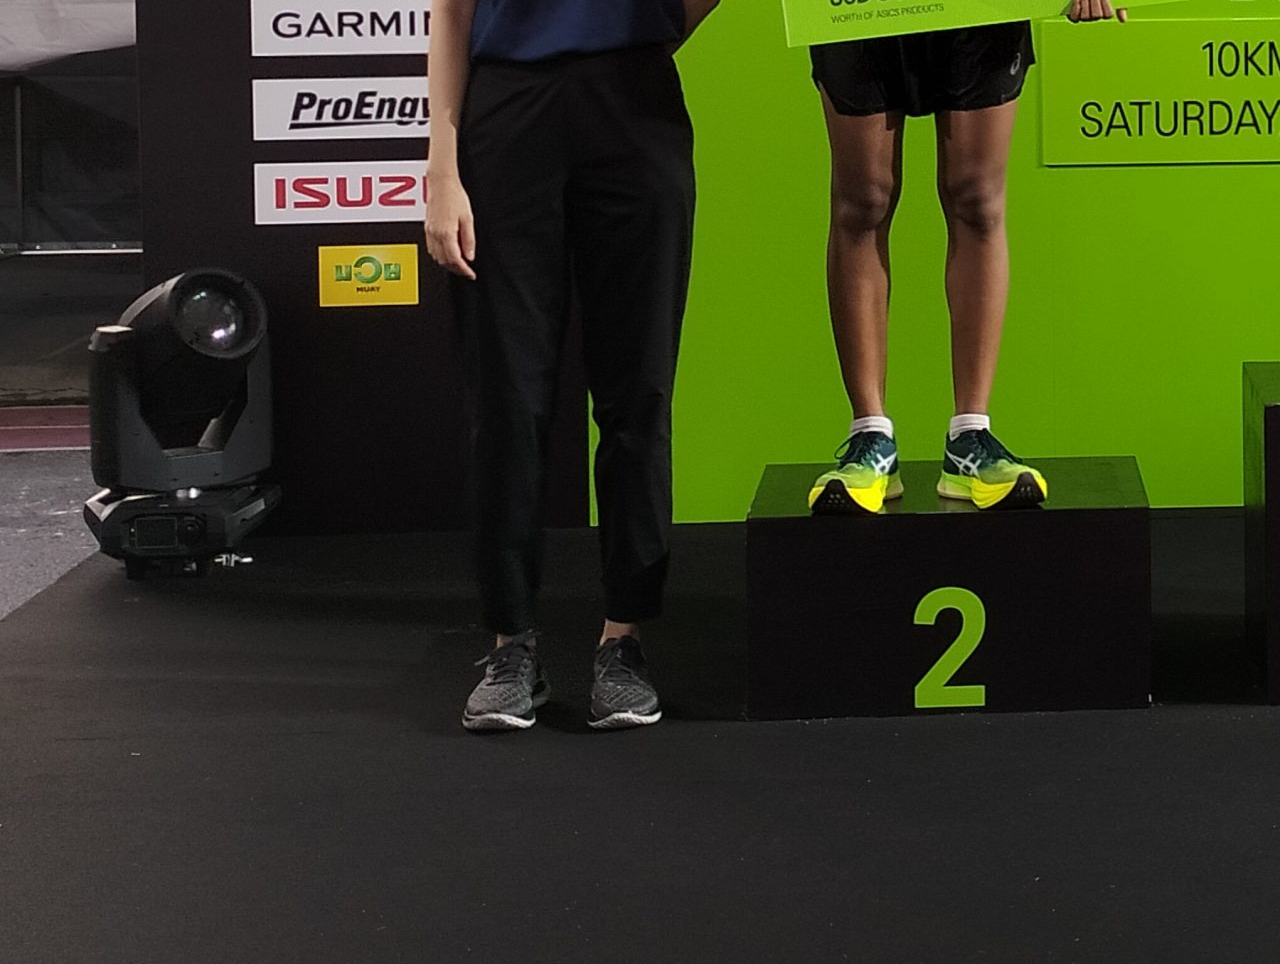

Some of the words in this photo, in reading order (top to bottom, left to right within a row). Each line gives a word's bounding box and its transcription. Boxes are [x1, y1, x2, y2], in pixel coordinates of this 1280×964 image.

[272, 11, 431, 39] GARMI
[831, 13, 864, 24] WORTH
[901, 3, 944, 18] PRODUCTS
[275, 176, 427, 210] ISUZ
[913, 586, 986, 708] 2
